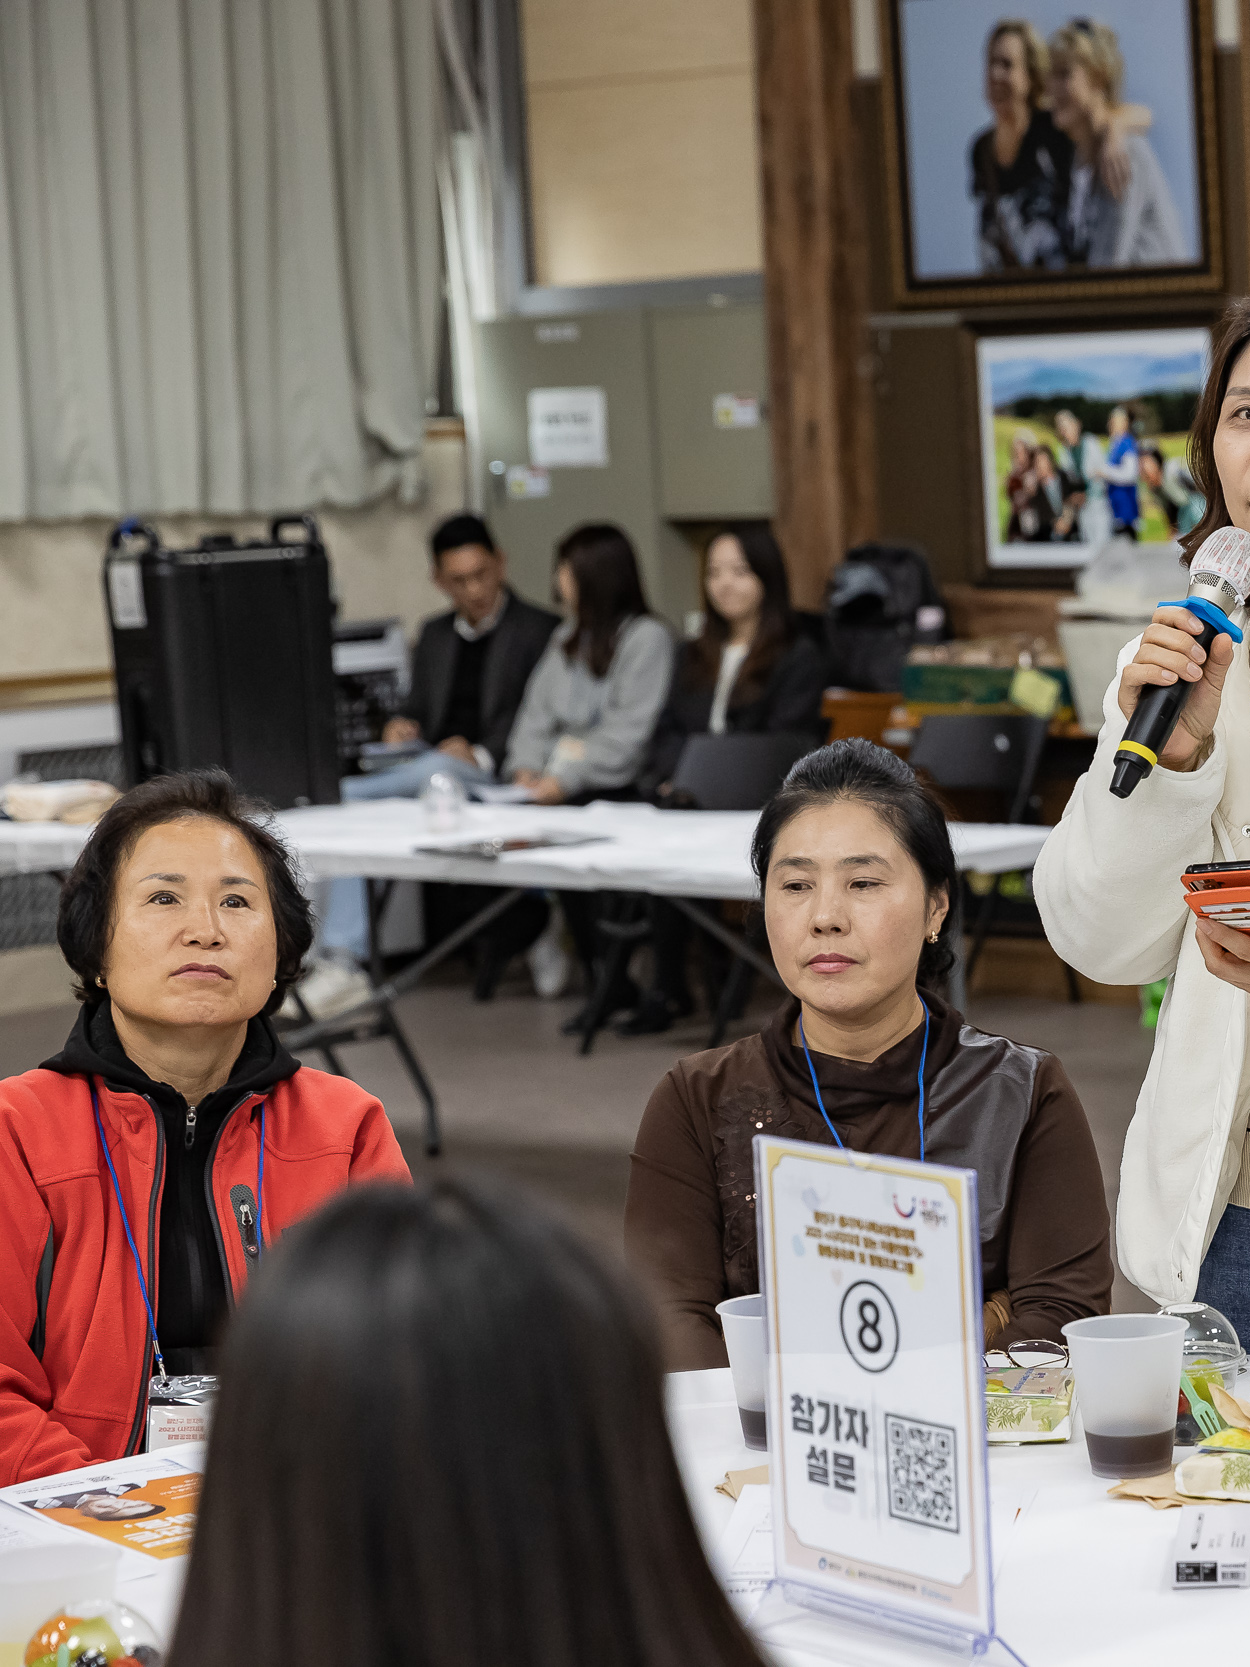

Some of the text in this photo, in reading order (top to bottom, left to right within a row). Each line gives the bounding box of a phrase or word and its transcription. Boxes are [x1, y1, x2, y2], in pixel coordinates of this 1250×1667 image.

[858, 1299, 882, 1353] 8
[791, 1393, 869, 1449] 참가자
[807, 1444, 856, 1493] 설문
